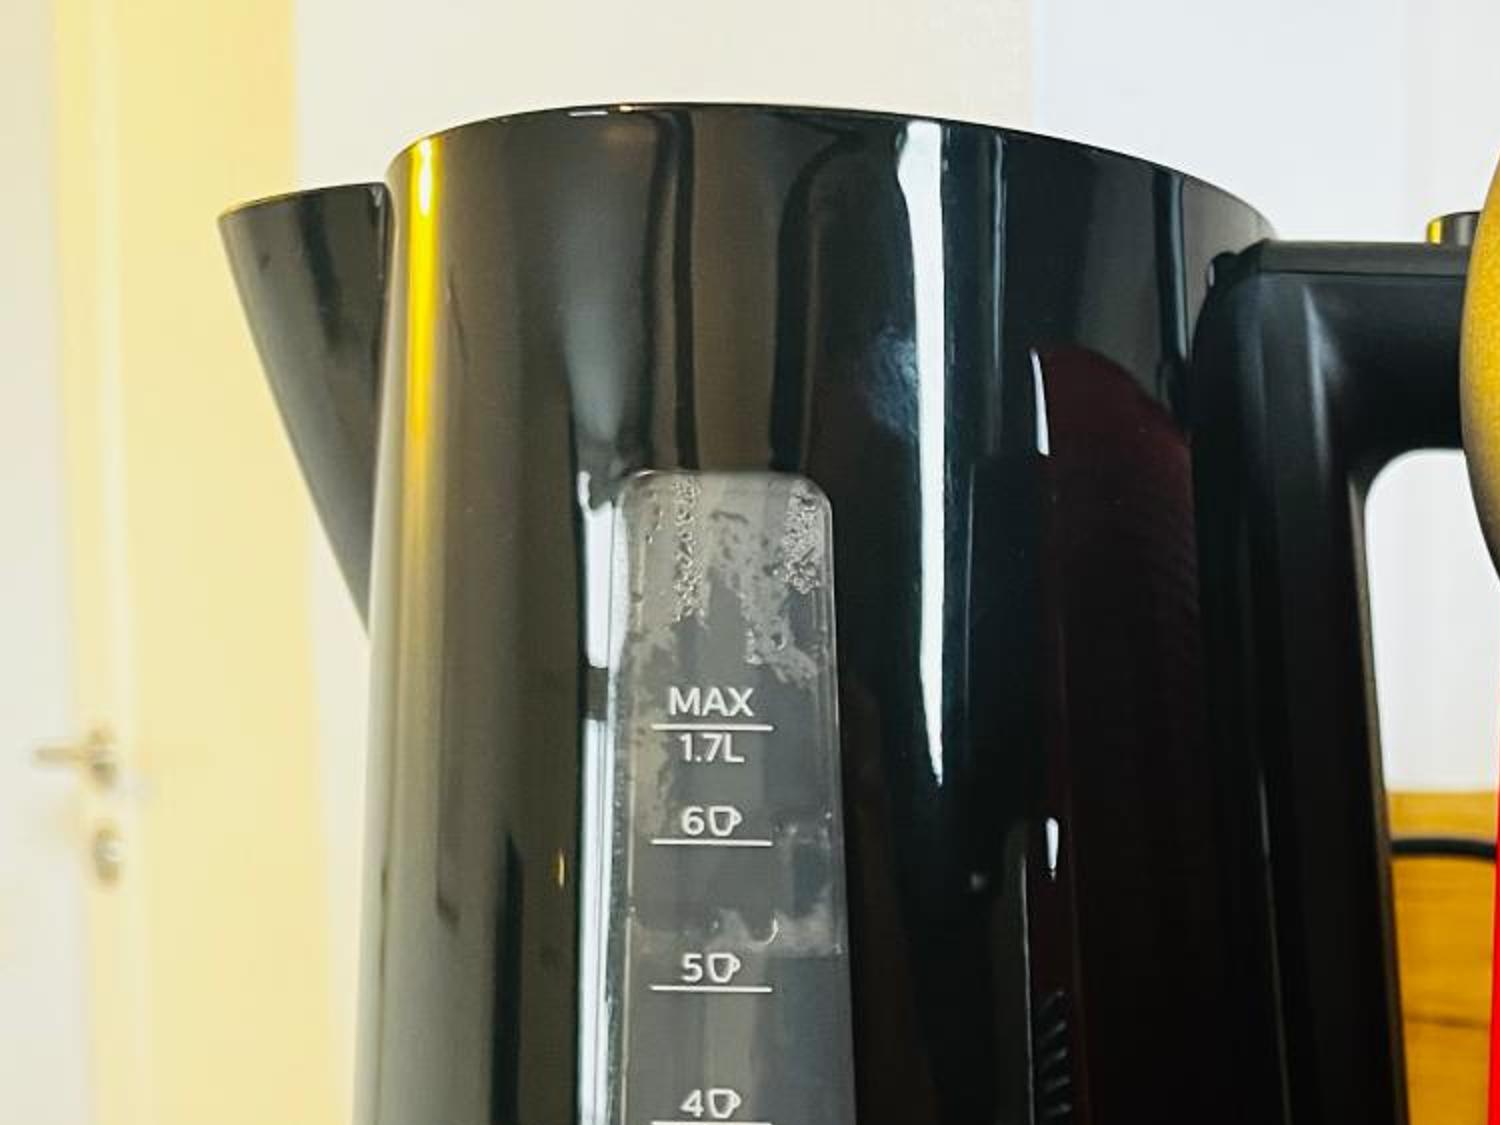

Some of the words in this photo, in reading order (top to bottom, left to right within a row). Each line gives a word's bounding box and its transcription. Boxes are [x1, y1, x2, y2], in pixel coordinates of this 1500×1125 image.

[669, 687, 753, 717] MAX
[680, 732, 745, 763] 1.7L
[682, 806, 703, 836] 6
[682, 953, 703, 983] 5
[681, 1089, 704, 1118] 4
